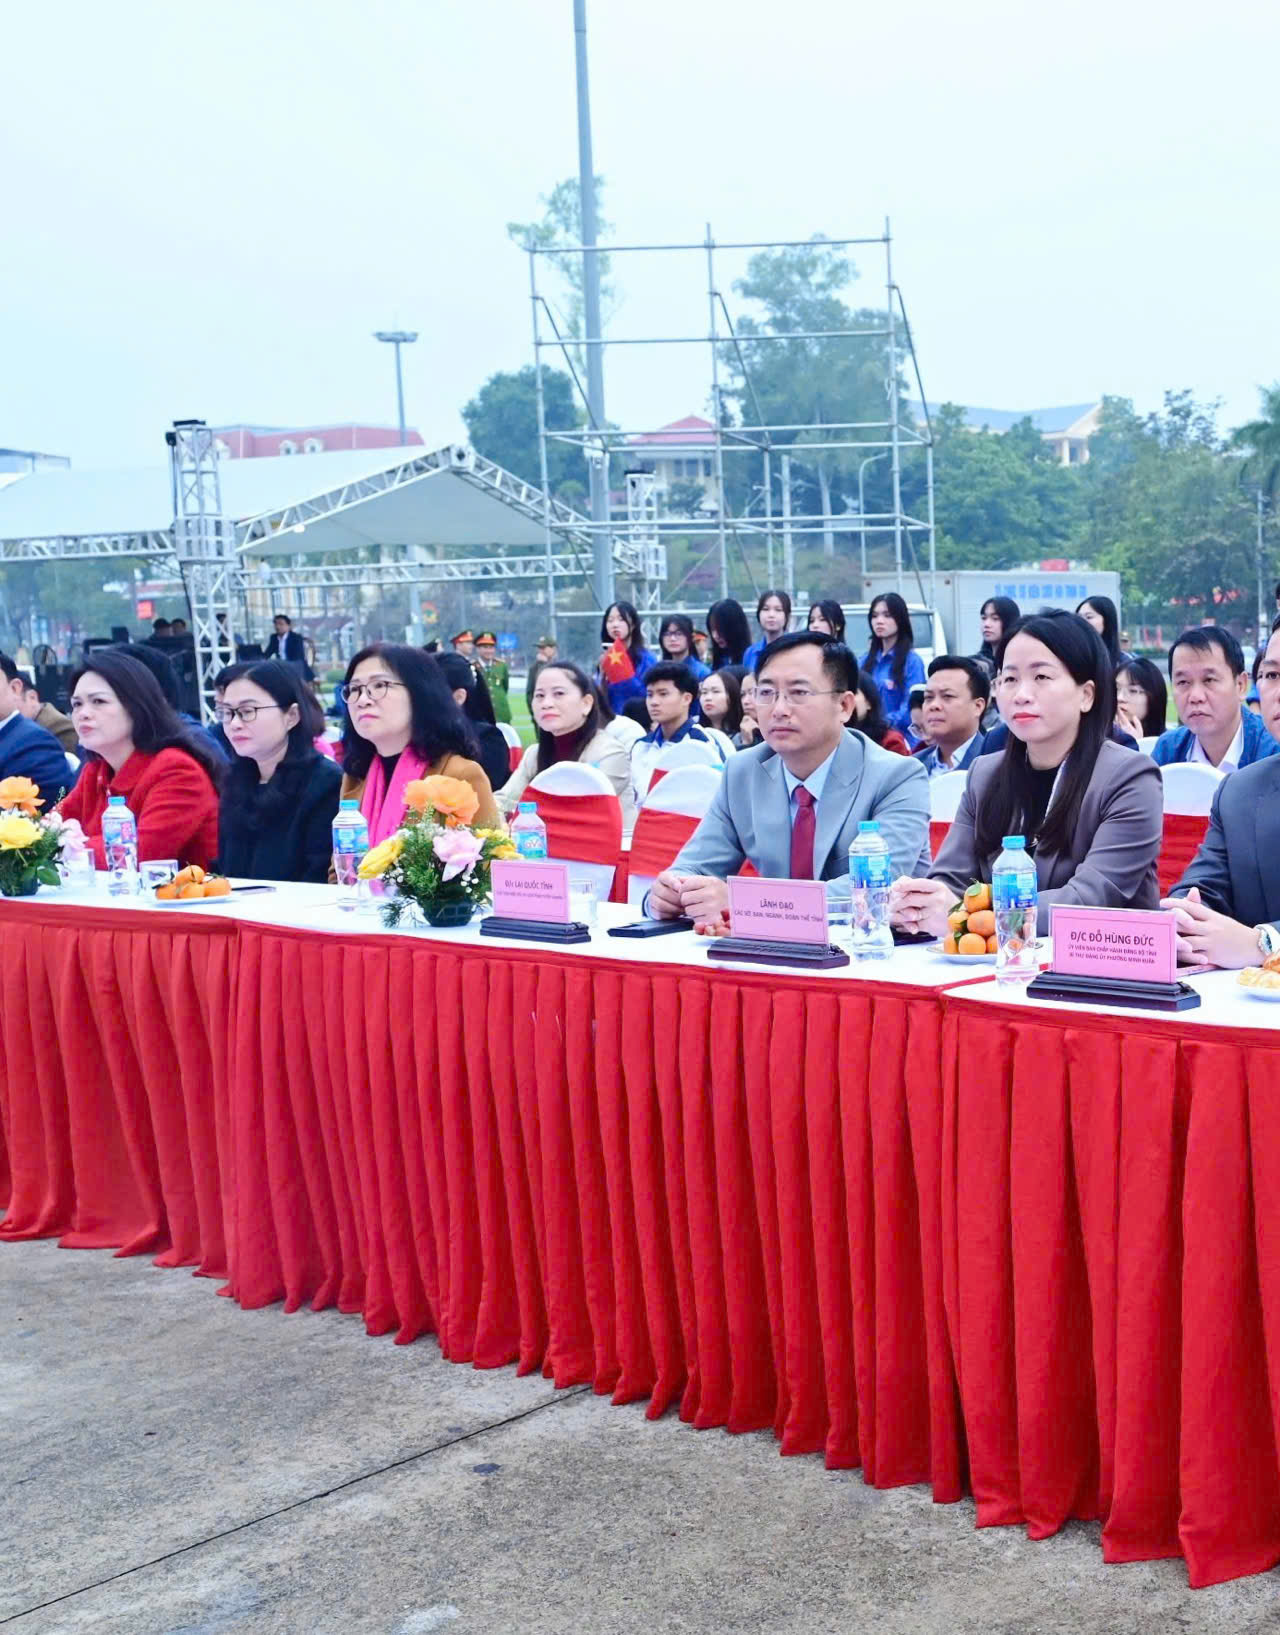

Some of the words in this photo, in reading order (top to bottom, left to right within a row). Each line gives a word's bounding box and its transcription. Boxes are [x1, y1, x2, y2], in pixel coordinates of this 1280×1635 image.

[1070, 931, 1087, 942] Đ/C
[1089, 930, 1102, 942] ĐỖ
[1104, 932, 1131, 945] HÙNG
[1134, 934, 1154, 946] ĐỨC
